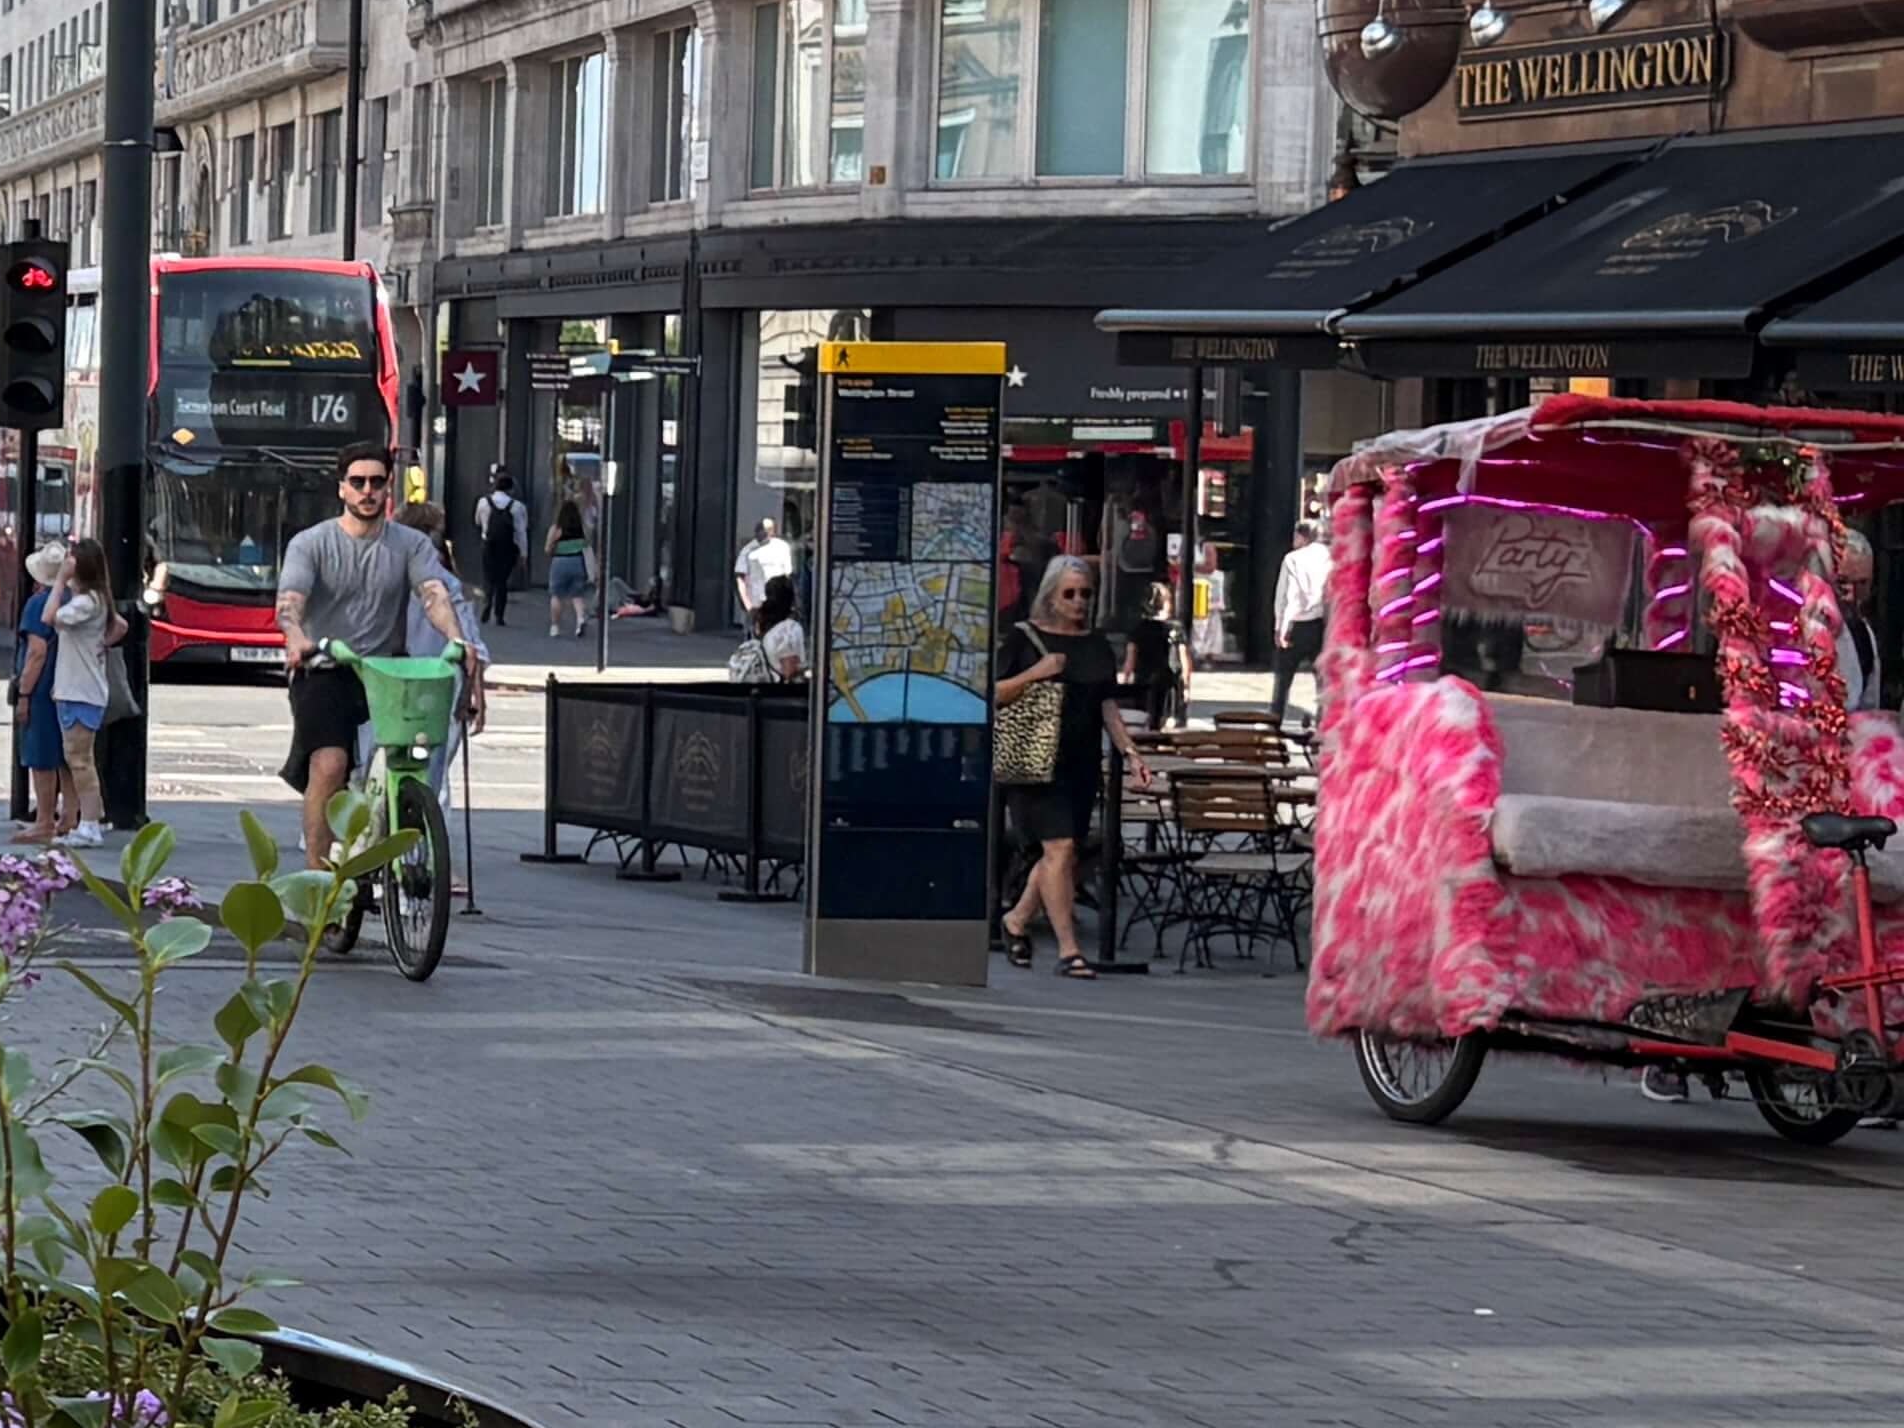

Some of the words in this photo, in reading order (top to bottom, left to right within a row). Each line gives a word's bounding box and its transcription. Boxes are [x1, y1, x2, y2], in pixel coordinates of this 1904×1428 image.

[1457, 60, 1512, 108] THE
[1518, 34, 1714, 103] WELLINGTON
[1476, 345, 1505, 369] THE
[1508, 345, 1609, 369] WELLINGTON
[1849, 354, 1886, 382] THE
[311, 393, 349, 424] 176
